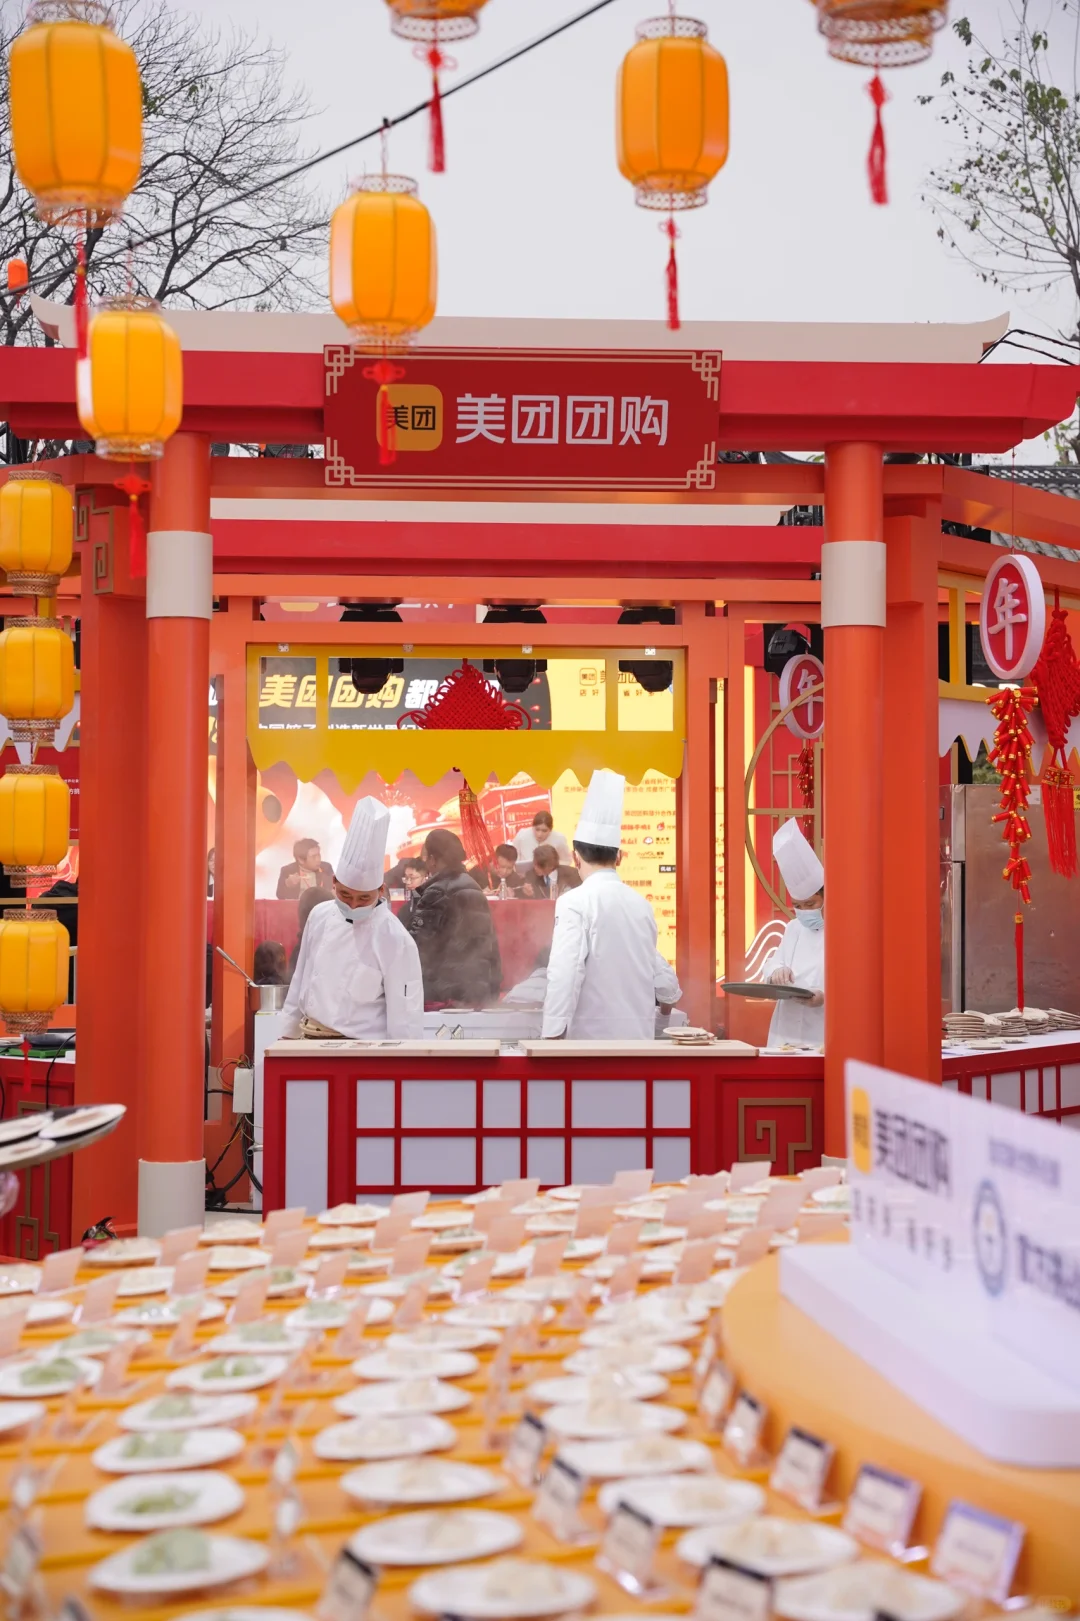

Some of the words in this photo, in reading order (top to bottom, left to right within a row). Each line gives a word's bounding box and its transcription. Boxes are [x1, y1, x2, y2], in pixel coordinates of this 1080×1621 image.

[384, 404, 436, 431] 美团
[455, 392, 669, 446] 美团团购
[987, 577, 1027, 661] 年
